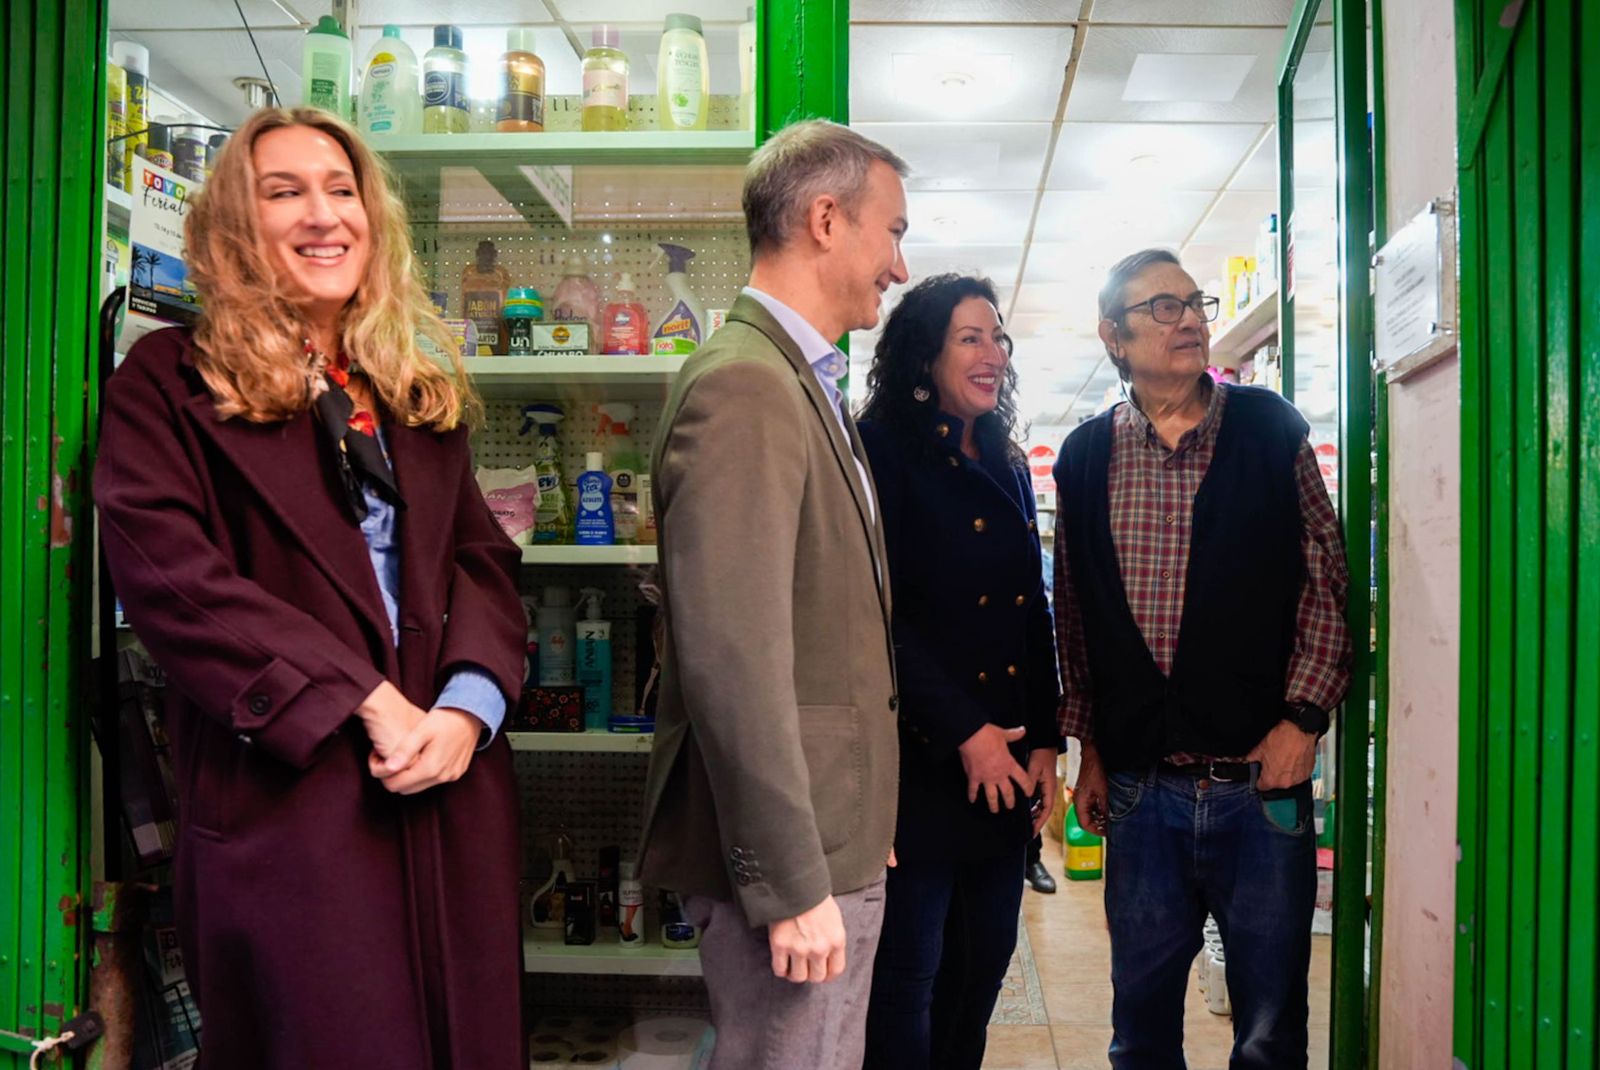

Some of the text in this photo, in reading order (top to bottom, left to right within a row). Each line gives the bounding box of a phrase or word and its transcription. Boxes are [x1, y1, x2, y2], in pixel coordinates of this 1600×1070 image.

[144, 171, 184, 198] TOYO
[663, 319, 689, 333] norit
[478, 335, 496, 343] ARTO
